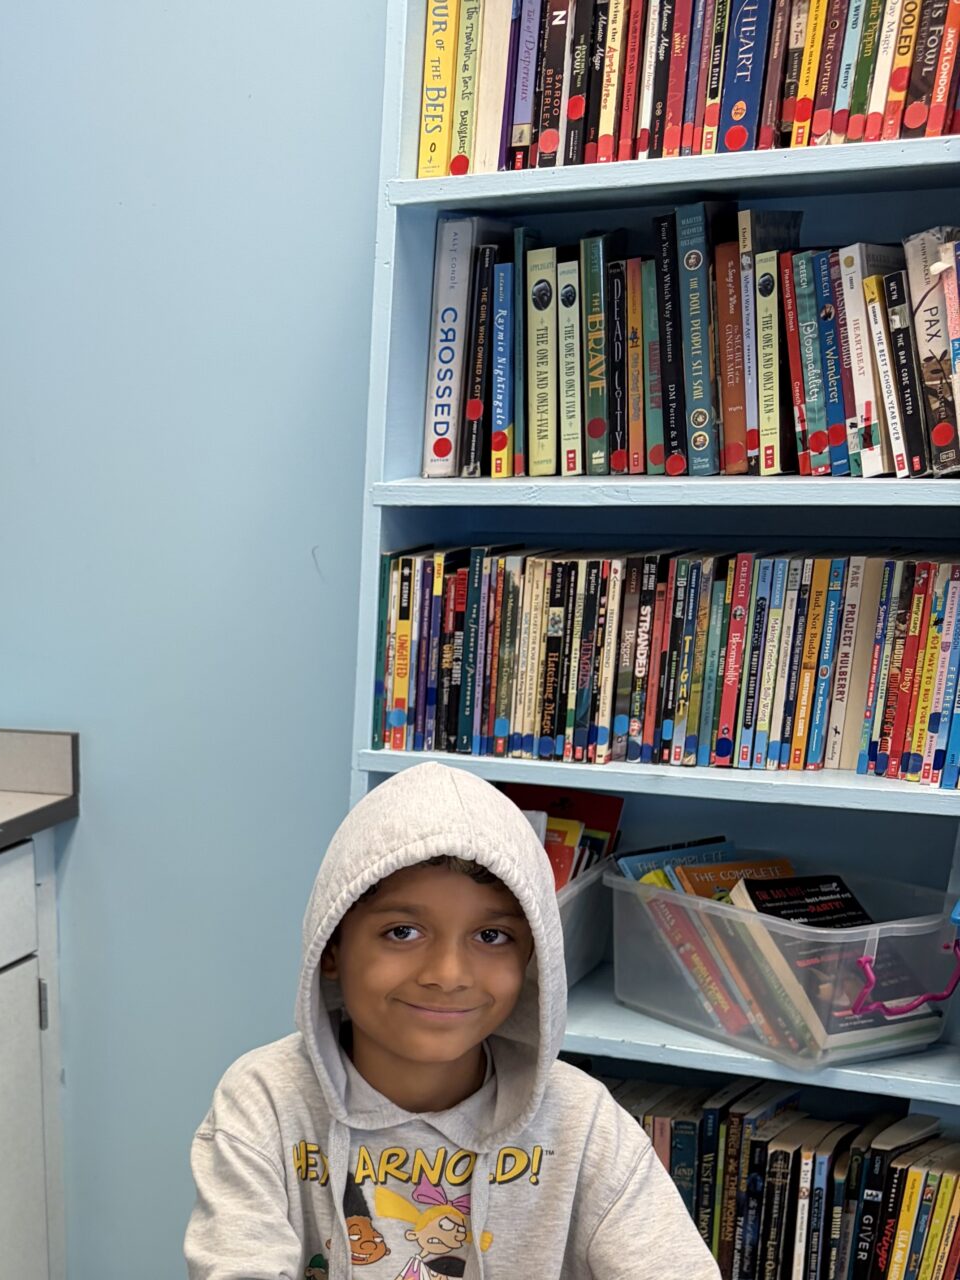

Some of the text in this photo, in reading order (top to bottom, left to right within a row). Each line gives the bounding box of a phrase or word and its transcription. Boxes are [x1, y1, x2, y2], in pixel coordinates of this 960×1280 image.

[436, 40, 444, 51] OF
[461, 7, 478, 100] the Traveling Pants
[673, 33, 683, 56] AWAY!
[734, 5, 758, 83] HEART
[842, 6, 860, 90] WIND Henry
[864, 22, 880, 57] Pippin
[882, 22, 896, 56] Magic
[897, 1, 918, 56] OOLED
[922, 25, 944, 76] FOWL
[431, 57, 442, 80] THE
[520, 10, 536, 102] Tale of Despereaux
[573, 46, 582, 76] FOWL
[602, 46, 618, 110] Applewhites
[820, 33, 836, 96] THE CAPTURE
[936, 28, 956, 102] JACK LONDON
[424, 86, 447, 134] BEES
[542, 69, 554, 127] BRIERLEY
[553, 74, 562, 116] SAROO
[450, 232, 458, 253] ALLY
[660, 242, 669, 257] You
[660, 259, 670, 272] Say
[662, 275, 672, 300] Which
[742, 275, 751, 292] When
[784, 269, 793, 303] Pleasing
[478, 326, 486, 345] WHO
[479, 304, 487, 323] GIRL
[613, 279, 623, 362] DEAD
[663, 302, 672, 318] Way
[744, 328, 752, 340] Age
[788, 312, 796, 332] Ghost
[798, 260, 820, 402] CREECH Bloomability
[819, 258, 839, 404] CREECH The Wanderer
[834, 280, 851, 369] CHASING REDBIRD
[922, 306, 942, 342] PAX
[476, 346, 484, 374] OWNED
[587, 292, 606, 397] THE BRAVE
[665, 321, 674, 362] Adventures
[688, 293, 702, 400] DOLL PEOPLE SET SAIL
[726, 324, 736, 387] GINGER MICE
[734, 334, 743, 369] SECRET
[762, 314, 775, 414] THE ONE AND ONLY IVAN
[852, 318, 865, 376] HEARTBEAT
[890, 281, 913, 415] WEYN THE BAR CODE TATTOO
[493, 309, 508, 426] Raymie Nightingale
[536, 326, 548, 440] THE ONE AND ONLY IVAN
[564, 324, 577, 420] THE ONE AND ONLY IVAN
[668, 384, 676, 400] DM
[875, 331, 900, 441] THE BEST SCHOOL YEAR EVER
[668, 403, 678, 428] Potter
[793, 382, 802, 405] Creech
[396, 582, 410, 678] KORMAN UNGIFTED
[634, 605, 651, 677] STRANDED
[726, 560, 748, 686] CREECH Bloomability
[806, 591, 823, 660] Bud, Not Buddy
[836, 565, 860, 703] PARK PROJECT MULBERRY
[442, 644, 453, 669] GIVER
[678, 636, 692, 716] TIGHT
[758, 618, 779, 722] Making Friends Billy Wong
[815, 600, 836, 724] ANIMORPHS The Solution
[900, 617, 920, 693] Cleary Ribsy
[924, 652, 937, 685] WAYS TO
[542, 652, 558, 734] Hatching Magic
[878, 674, 888, 700] PAULSEN
[941, 667, 956, 722] FEATHERS
[693, 865, 782, 882] THE COMPLETE
[355, 1145, 543, 1186] ARNOD!
[702, 1154, 714, 1184] WEST
[728, 1176, 737, 1198] THE
[726, 1200, 737, 1241] WOMAN
[856, 1215, 874, 1260] GIVER
[876, 1218, 896, 1272] Wringer
